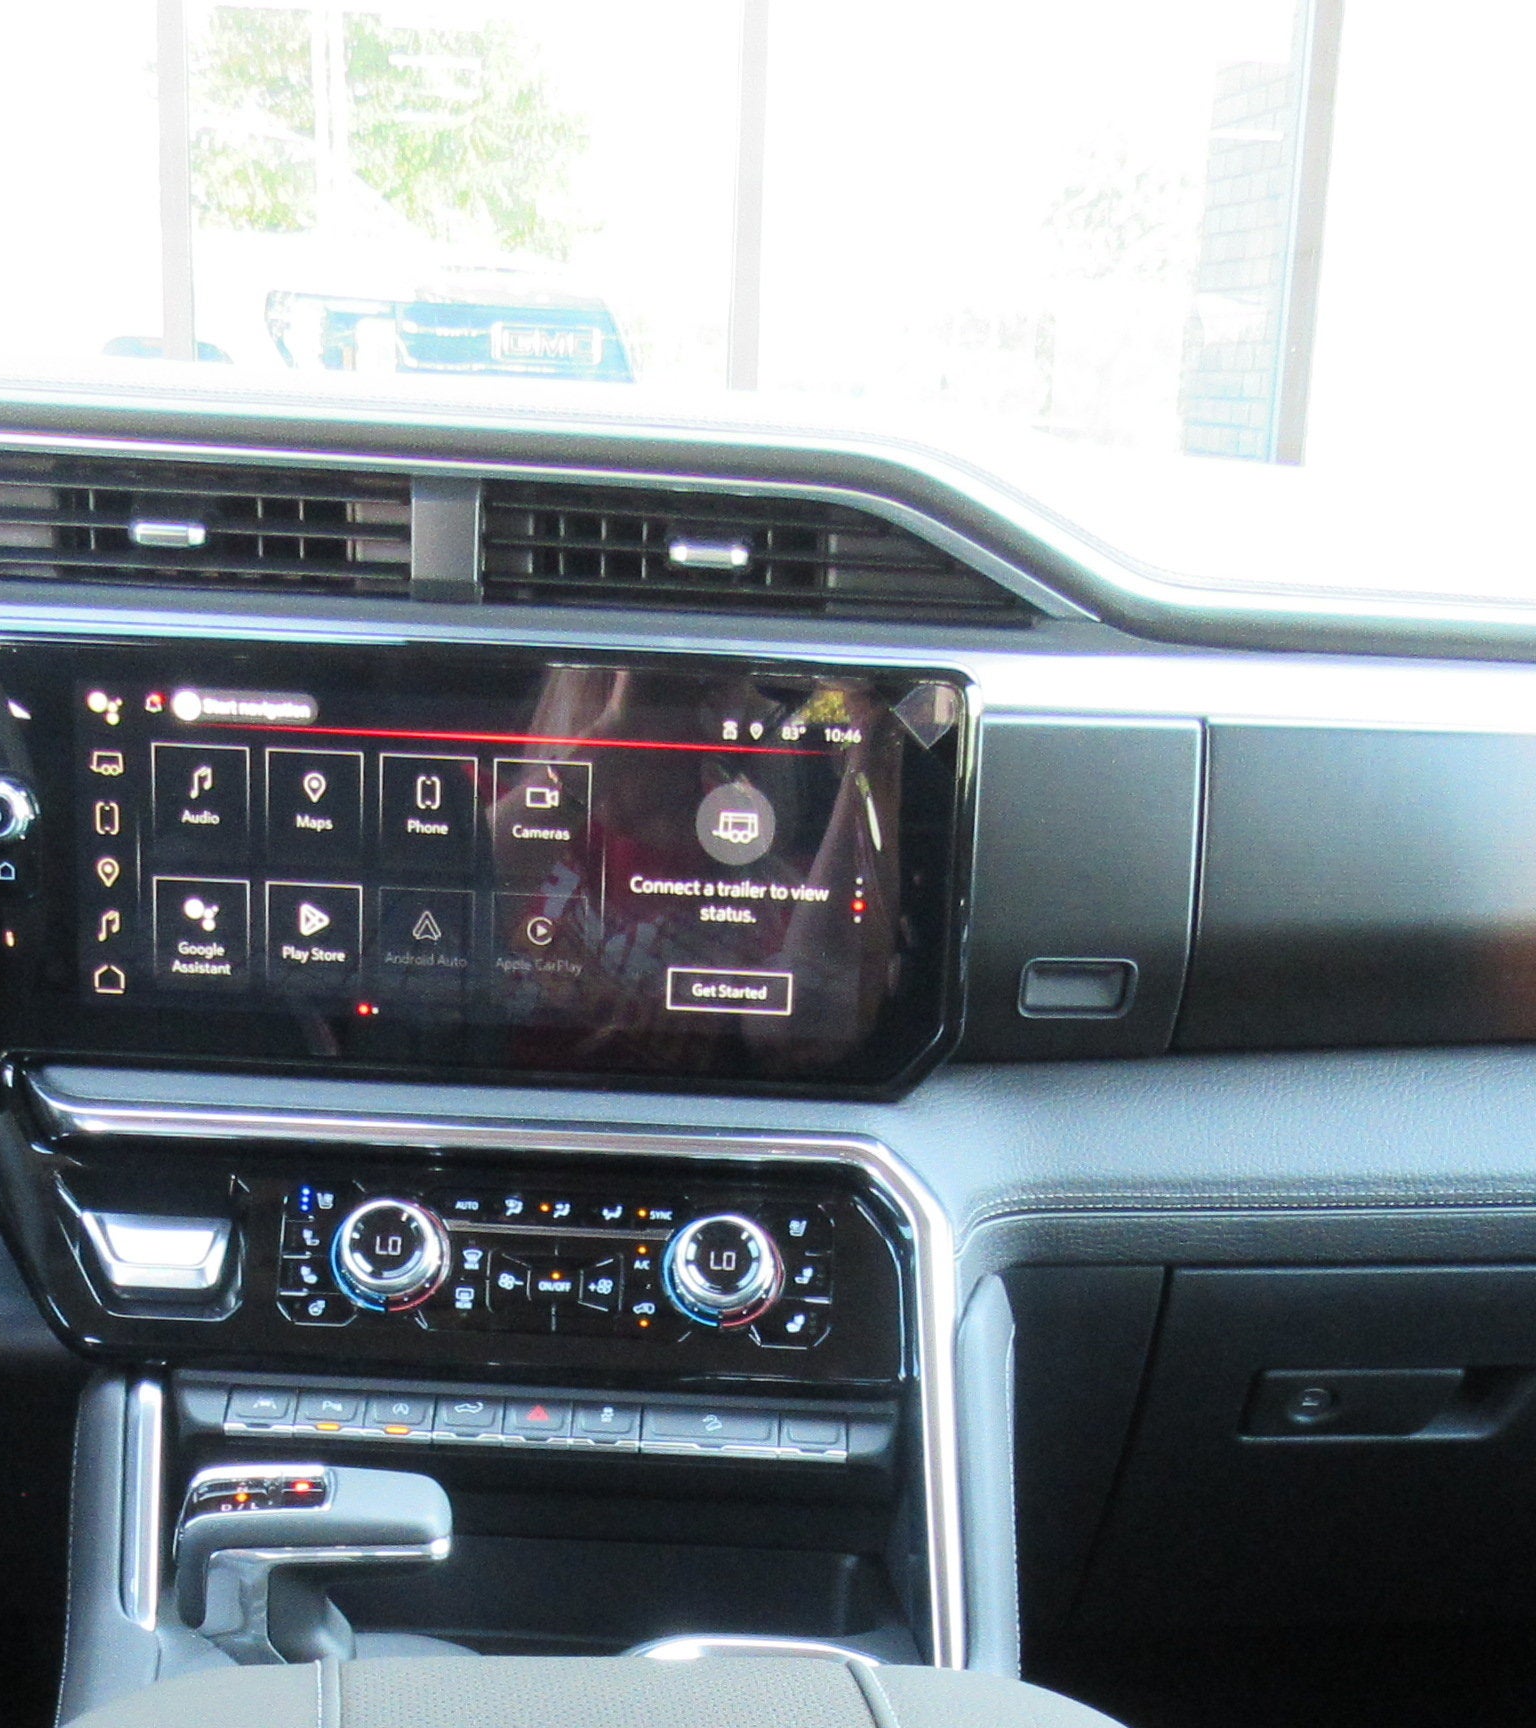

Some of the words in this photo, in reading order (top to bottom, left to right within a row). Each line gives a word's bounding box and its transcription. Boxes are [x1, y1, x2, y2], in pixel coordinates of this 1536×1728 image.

[502, 327, 598, 358] GMC
[203, 698, 236, 715] Start
[239, 701, 311, 720] navigation
[824, 726, 862, 744] 10:46
[181, 810, 220, 825] Audio
[296, 815, 333, 832] Maps
[407, 818, 449, 835] Phone
[512, 825, 570, 841] Cameras
[629, 876, 701, 896] Connect
[703, 882, 714, 896] a
[716, 880, 767, 898] trailer
[769, 883, 789, 901] to
[790, 885, 830, 902] view
[699, 906, 757, 924] status.
[178, 941, 225, 959] Google
[282, 945, 309, 964] Play
[311, 947, 346, 962] Store
[171, 960, 232, 976] Assistant
[385, 951, 435, 967] Android
[437, 953, 468, 968] Auto
[496, 957, 532, 973] Apple
[692, 983, 718, 999] Get
[720, 984, 767, 1001] Started
[455, 1201, 479, 1211] AUTO
[649, 1210, 673, 1221] SYNC
[633, 1260, 650, 1270] A/C
[538, 1280, 571, 1293] ON/OFF
